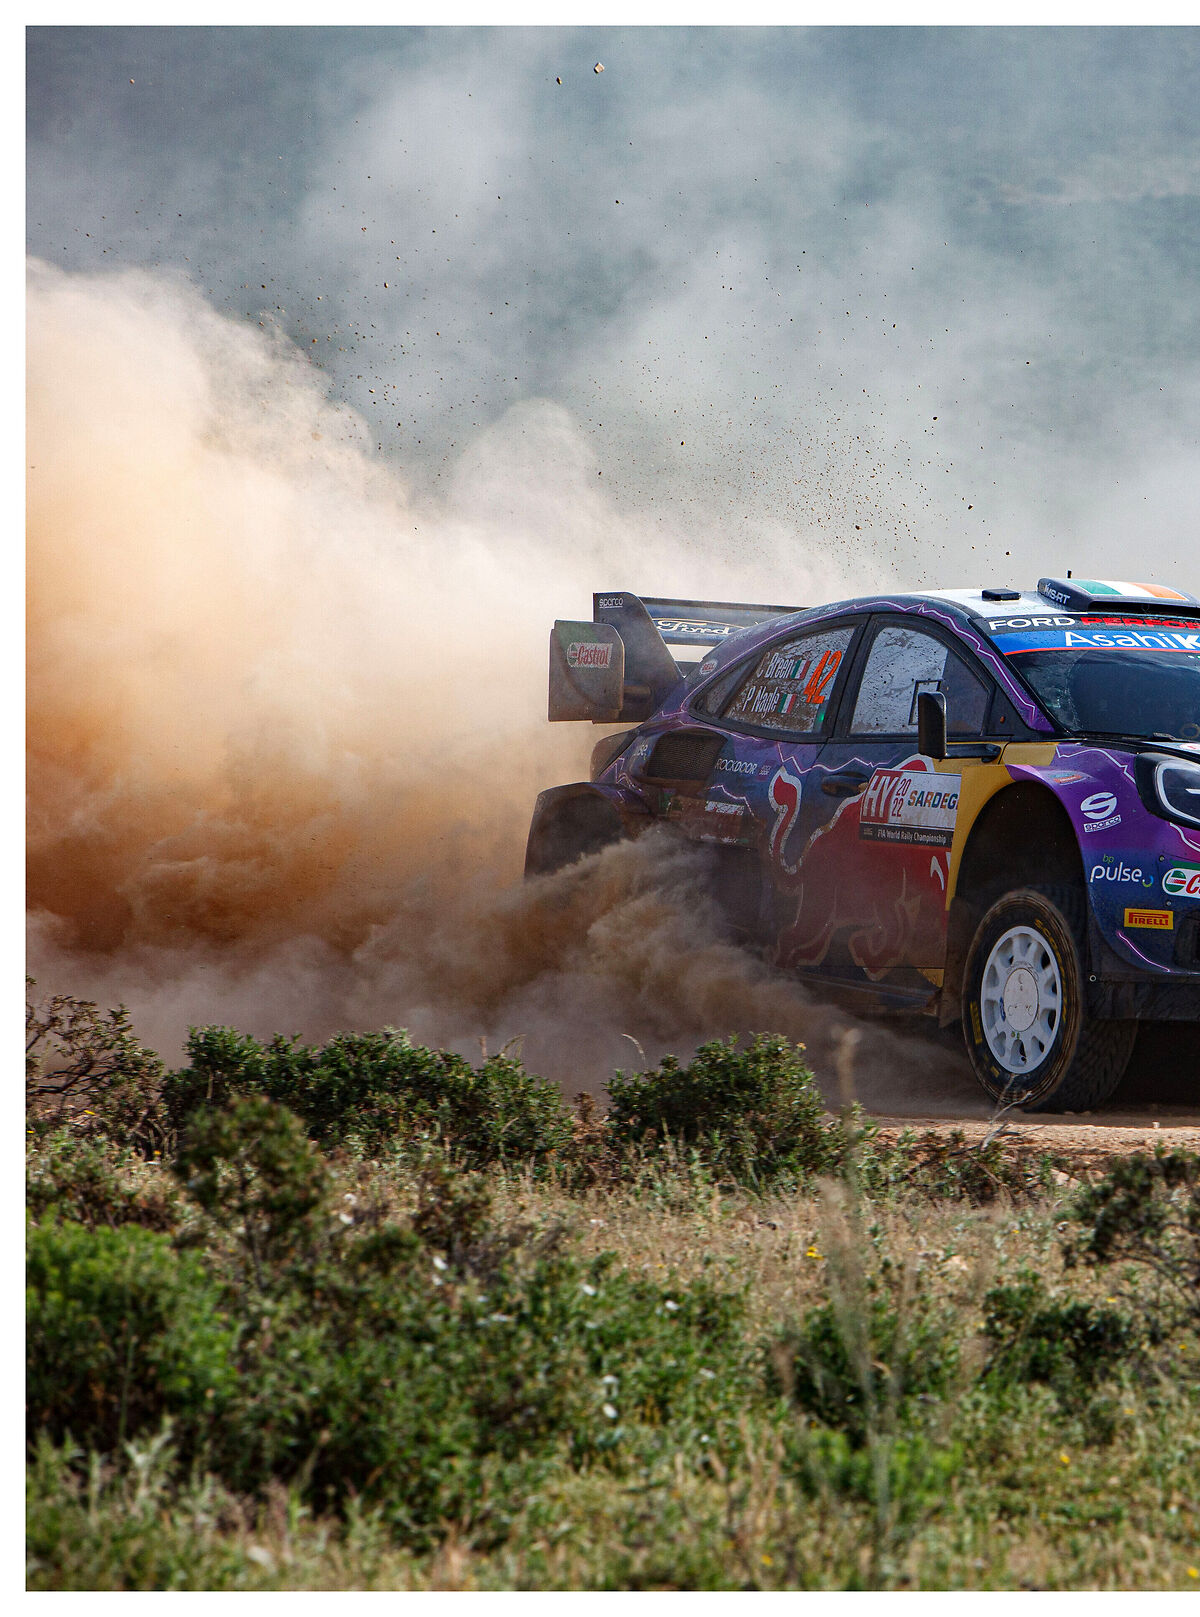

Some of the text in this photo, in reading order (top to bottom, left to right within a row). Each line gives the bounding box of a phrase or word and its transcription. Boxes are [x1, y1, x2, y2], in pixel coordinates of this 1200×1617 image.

[656, 620, 730, 636] Ford
[988, 617, 1076, 631] FORD
[577, 646, 610, 667] Castrol
[764, 652, 796, 679] Breen
[803, 650, 842, 704] 42
[742, 686, 780, 719] P Nagle
[714, 758, 758, 774] ROCKDOOR
[896, 778, 912, 797] 20
[891, 798, 904, 818] 22
[907, 790, 958, 811] SARDEG
[1085, 815, 1121, 832] sparco
[1102, 854, 1115, 865] bp
[1090, 861, 1143, 883] pulse
[1128, 912, 1169, 926] PIRELLI
